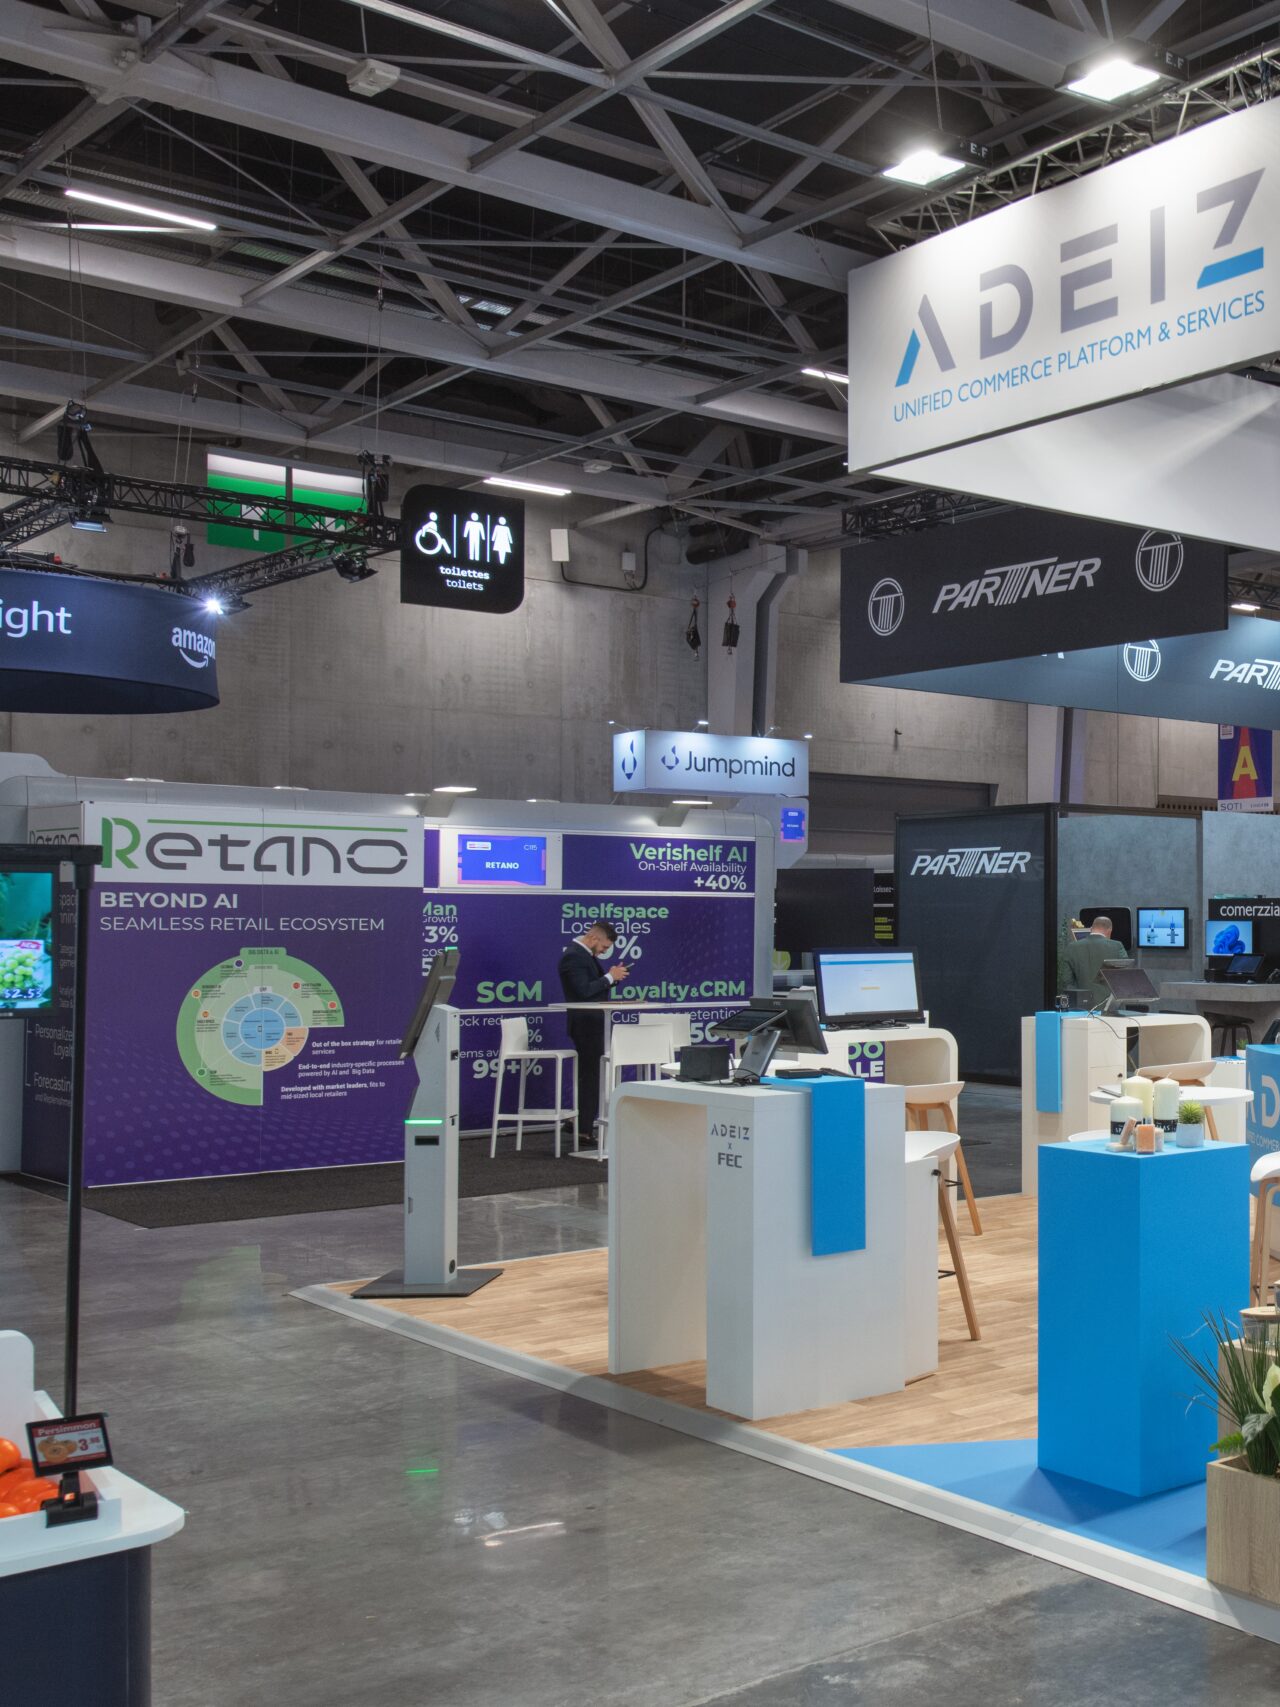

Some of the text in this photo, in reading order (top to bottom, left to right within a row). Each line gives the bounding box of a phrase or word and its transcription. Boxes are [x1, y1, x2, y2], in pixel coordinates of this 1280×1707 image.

[895, 168, 1266, 387] ADEIZ
[894, 290, 1266, 422] UNIFIED COMMERCE PLATFORM & SERVICES
[440, 566, 490, 579] toilettes
[446, 579, 484, 591] toilets
[932, 556, 1102, 614] PARTNER
[172, 627, 216, 660] amazon
[685, 751, 795, 778] Jumpmind
[1232, 745, 1258, 781] A
[630, 843, 747, 862] Verishelf AI
[485, 861, 520, 870] RETANO
[638, 861, 747, 874] On-Shelf Availability
[910, 847, 1032, 877] PARTNER
[694, 874, 747, 891] +40%
[100, 892, 239, 909] BEYOND AI
[561, 903, 669, 921] Shelfspace
[1220, 902, 1280, 917] comerzzia
[100, 917, 384, 932] SEAMLESS RETAIL ECOSYSTEM
[476, 981, 542, 1003] SCM
[353, 1040, 375, 1048] strategy
[331, 1061, 376, 1069] industry-specific
[298, 1070, 322, 1078] powered
[281, 1084, 311, 1093] Developed
[281, 1092, 309, 1100] mid-sized
[710, 1123, 750, 1141] ADEIZ
[718, 1152, 742, 1168] FEC
[38, 1422, 96, 1436] Persimmon
